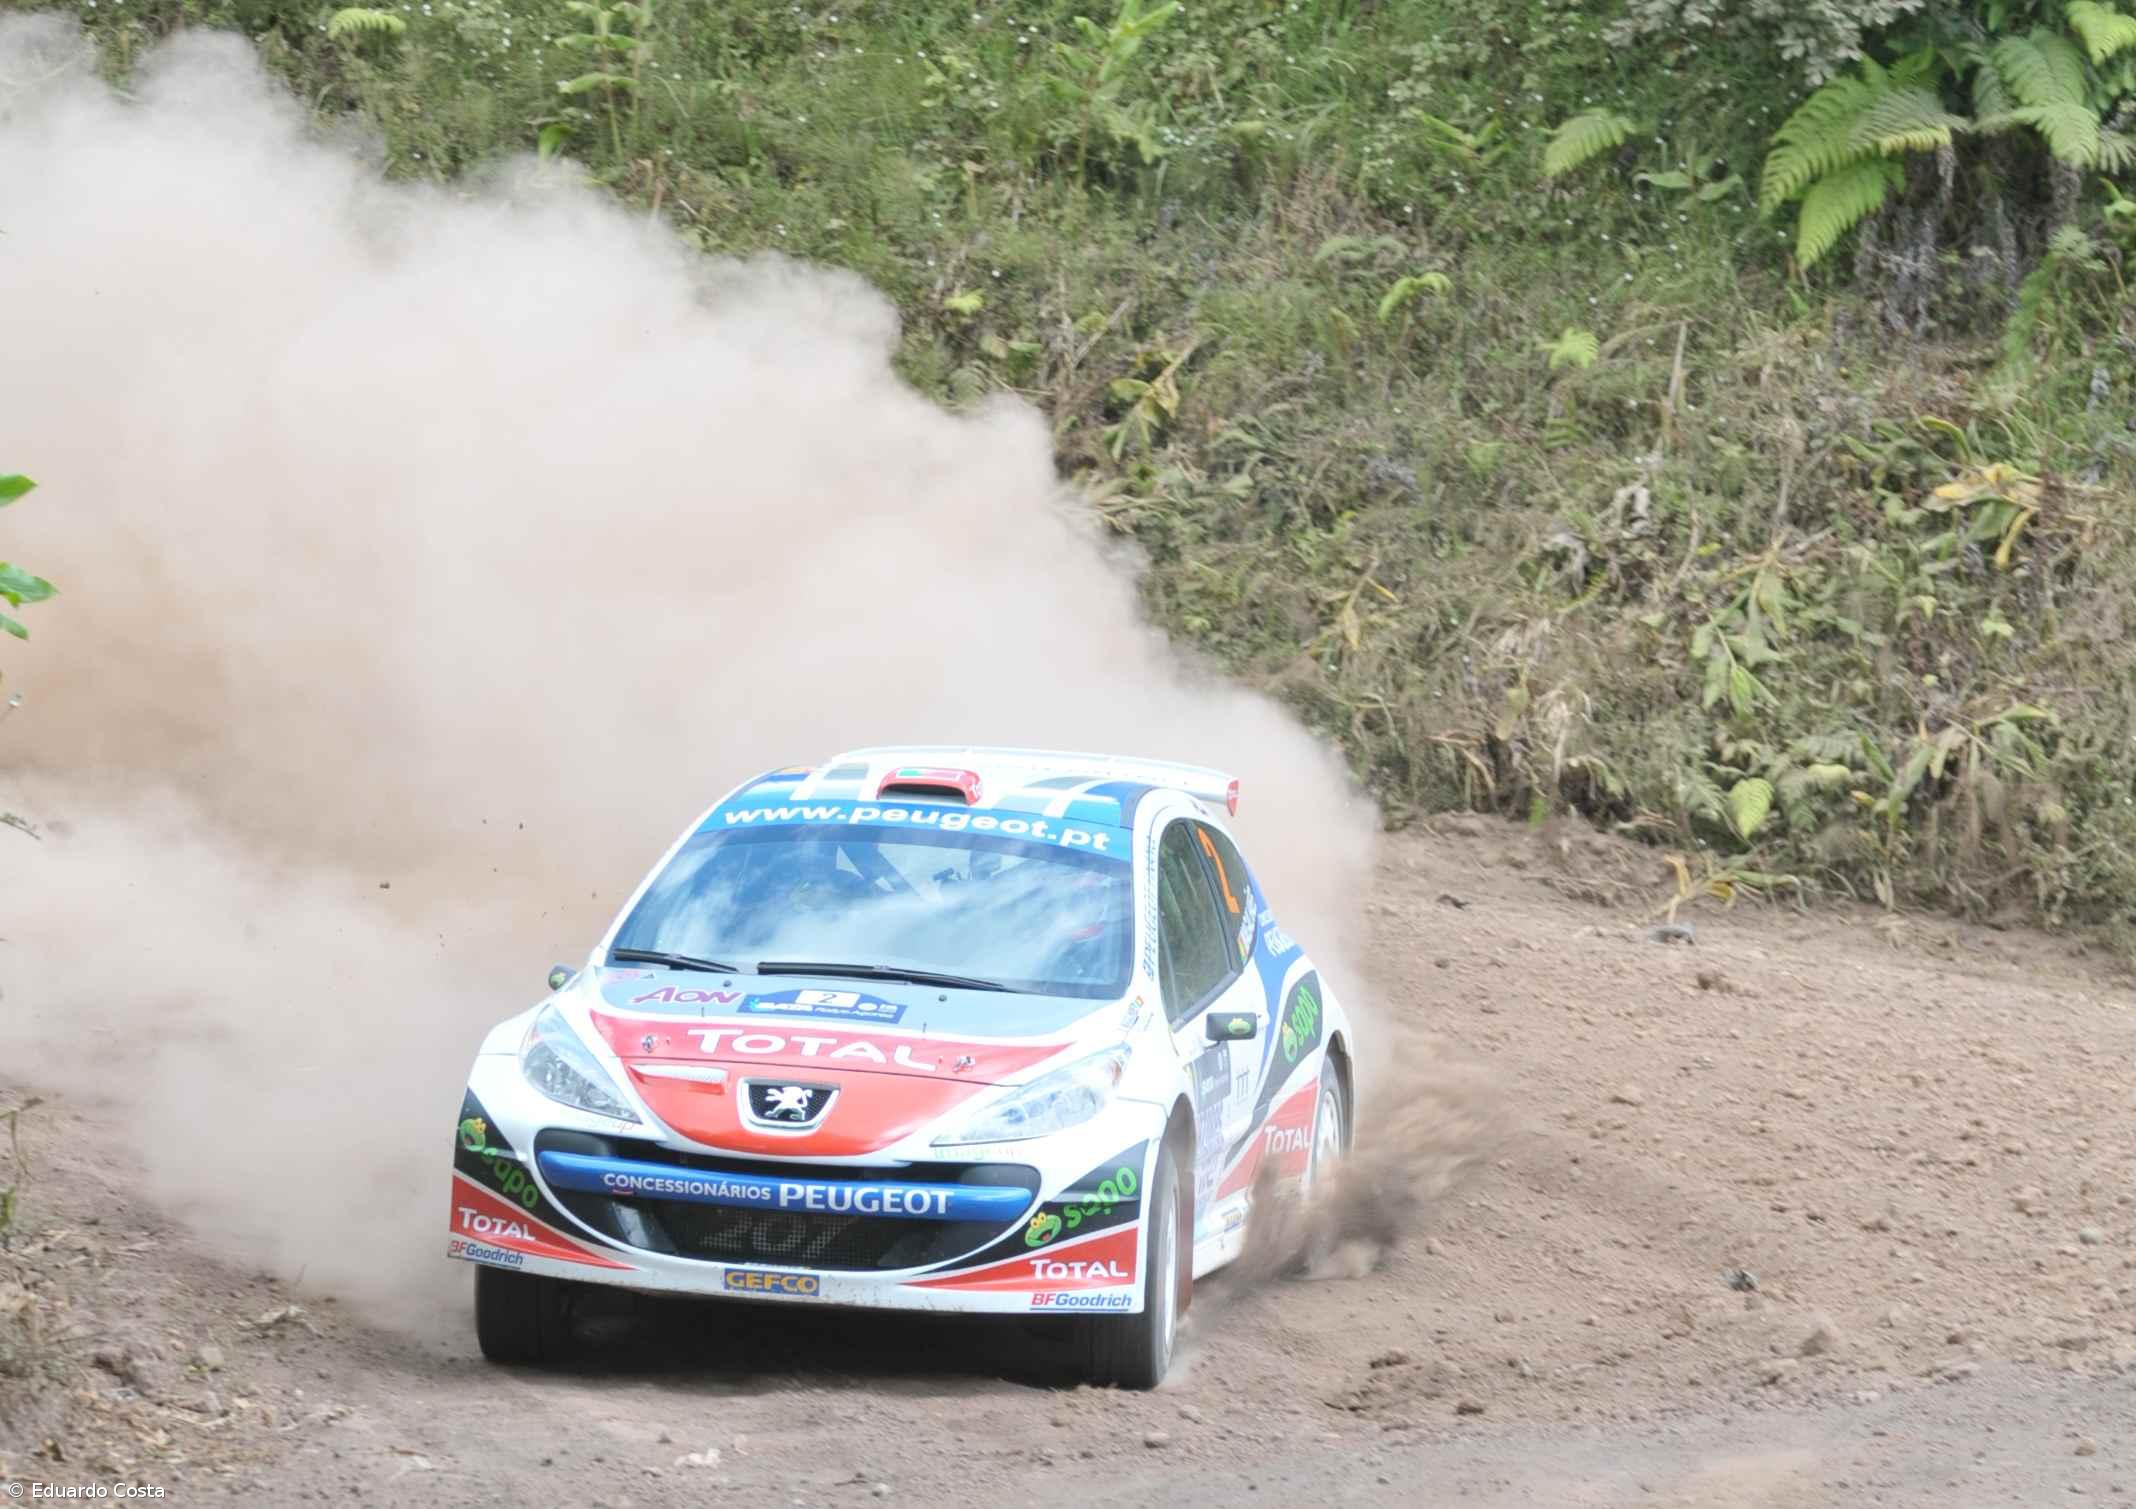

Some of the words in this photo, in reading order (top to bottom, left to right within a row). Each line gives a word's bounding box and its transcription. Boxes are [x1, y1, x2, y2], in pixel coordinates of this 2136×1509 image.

[724, 802, 1110, 851] www.peugeot.pt
[817, 992, 838, 1004] 2
[687, 1027, 937, 1073] TOTAL
[603, 1172, 771, 1201] CONCESSIONÁRIOS
[779, 1182, 954, 1215] PEUGEOT
[1063, 1166, 1138, 1229] sapo
[725, 1271, 818, 1294] GEFCO
[1030, 1291, 1132, 1308] BFGoodrich
